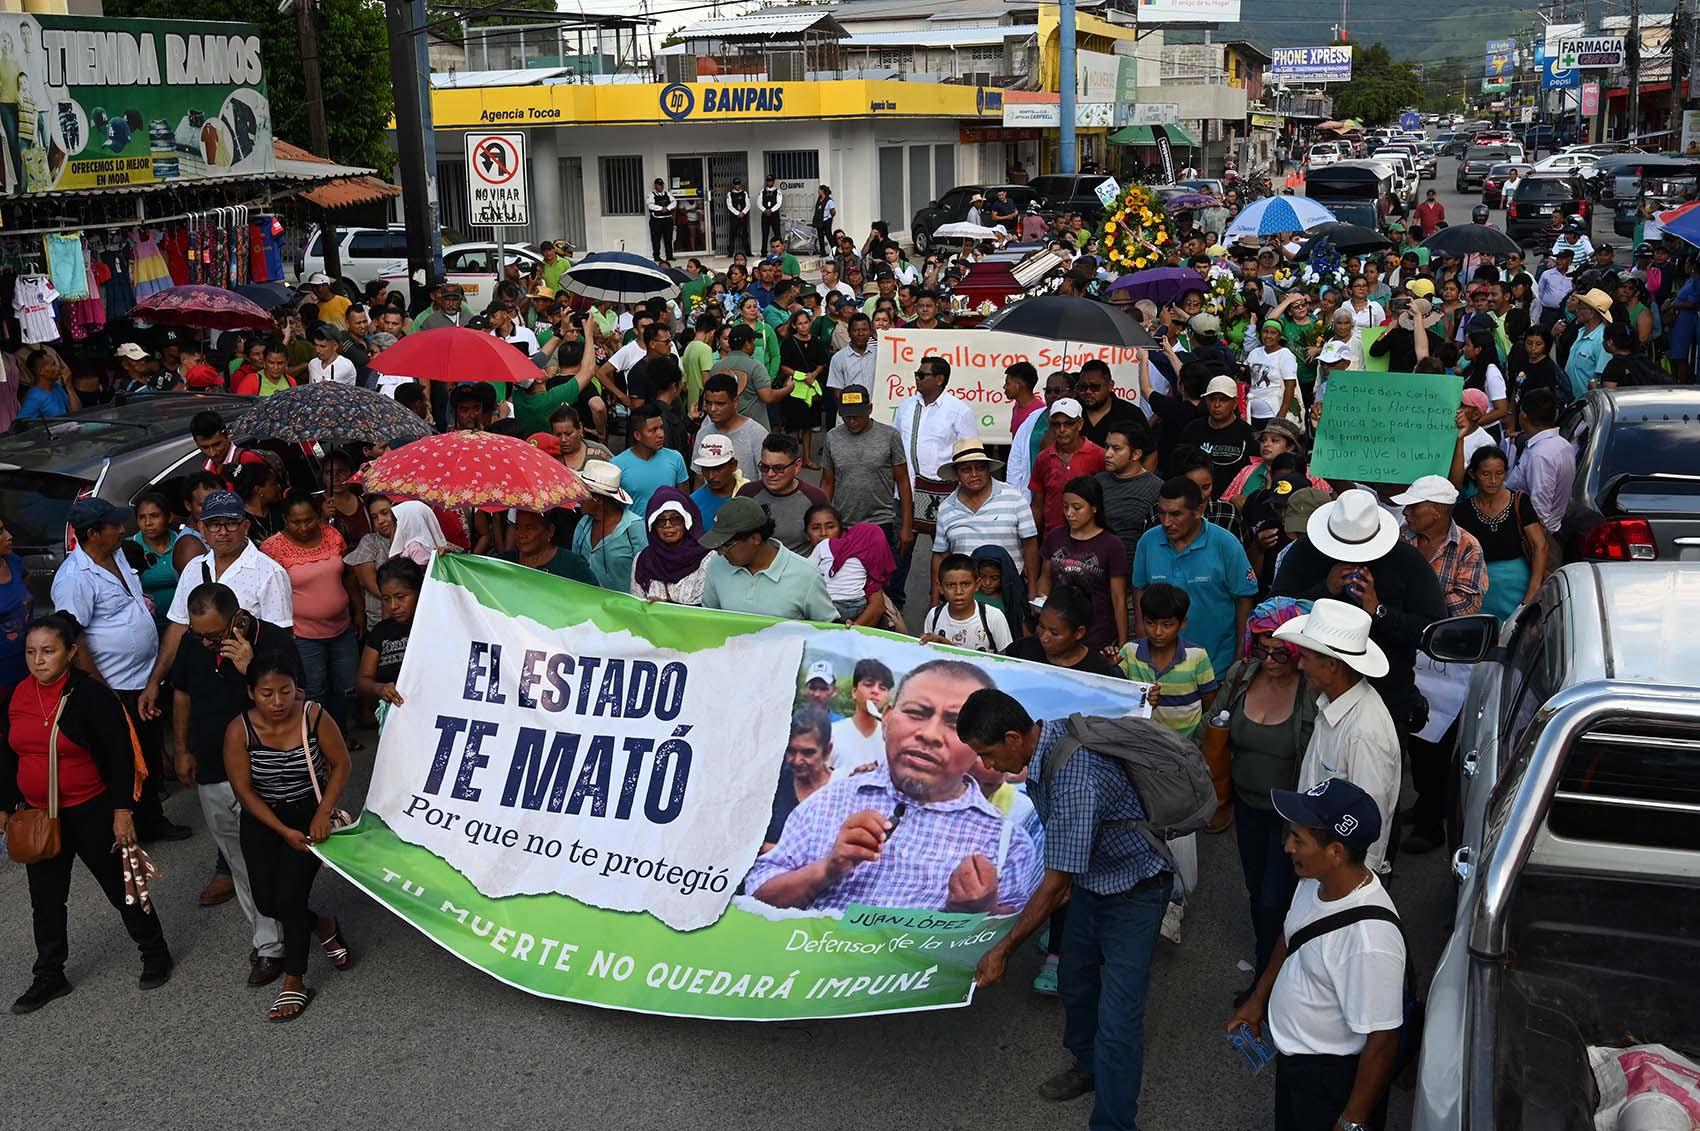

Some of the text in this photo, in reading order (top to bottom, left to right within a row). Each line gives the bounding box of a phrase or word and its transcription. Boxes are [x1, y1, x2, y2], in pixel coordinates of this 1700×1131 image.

[1273, 47, 1350, 66] PHONE XPRESS
[1561, 40, 1623, 54] FARMACIA
[42, 29, 263, 86] TIENDA RAMOS
[1549, 78, 1571, 87] pepsi
[703, 87, 784, 112] BANPAIS
[480, 107, 561, 123] Agencia Tocoa
[71, 158, 150, 174] OFRECEMOS LO MEJOR
[96, 172, 130, 186] EN MODA
[475, 188, 520, 201] NO VIRAR
[884, 336, 915, 365] Te
[1038, 343, 1095, 372] Según
[887, 374, 918, 401] Per
[1328, 380, 1349, 393] Se
[1352, 384, 1402, 400] pueden
[1328, 399, 1361, 412] todas
[1367, 400, 1382, 413] las
[1426, 406, 1453, 422] pero
[1327, 418, 1366, 429] nunca
[1390, 418, 1422, 434] podra
[1323, 428, 1396, 447] la primavera
[1327, 447, 1358, 461] Juan
[1396, 446, 1407, 460] la
[462, 640, 689, 722] EL ESTADO
[422, 714, 694, 825] TE MATÓ
[1334, 814, 1359, 837] 3
[401, 794, 730, 896] Por que no te protegió
[849, 912, 972, 930] JUAN LÓPEZ
[381, 867, 939, 1000] TU MUERTE NO QUEDARÁ IMPUNE
[784, 928, 997, 955] Defensor de la vida
